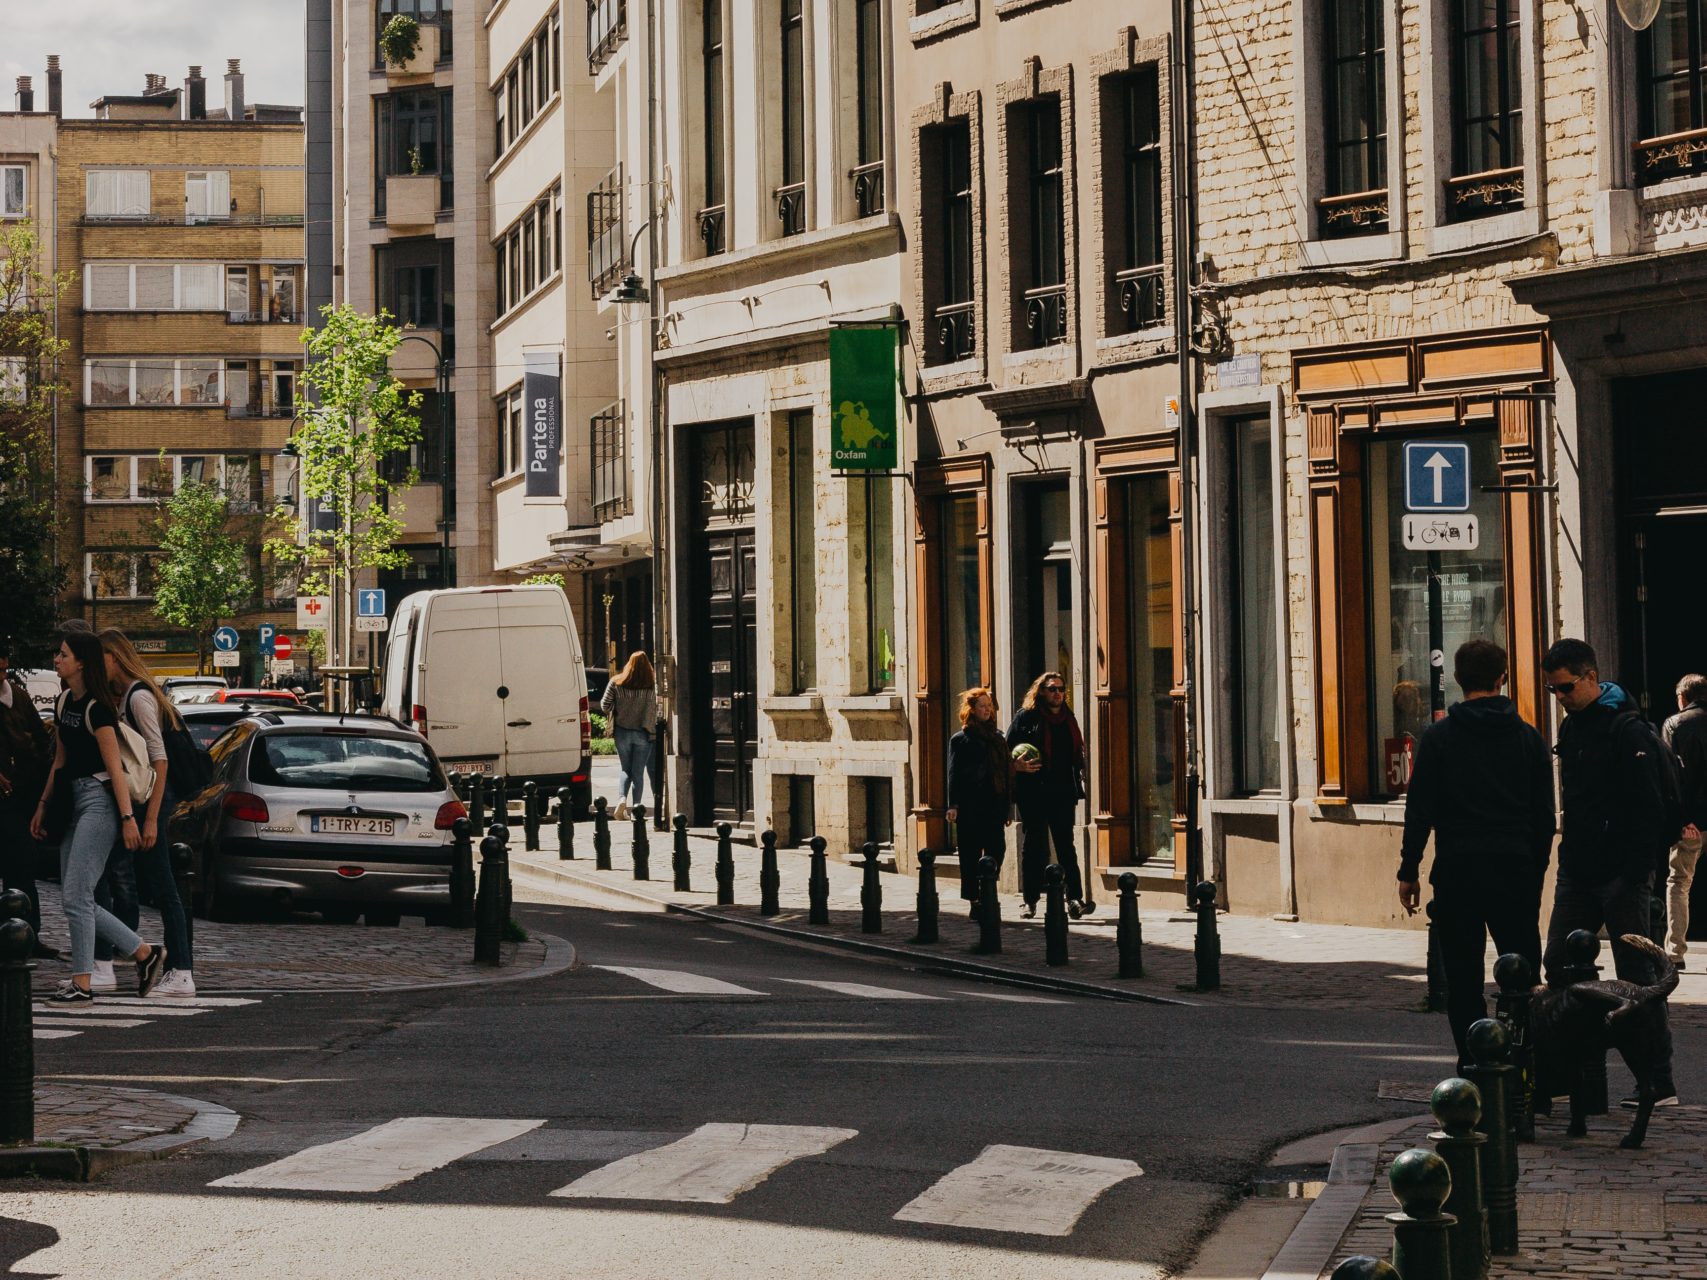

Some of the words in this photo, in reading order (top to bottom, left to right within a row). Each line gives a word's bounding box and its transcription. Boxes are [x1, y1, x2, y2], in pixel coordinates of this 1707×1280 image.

[530, 398, 547, 472] Partena
[835, 450, 867, 459] Oxfam
[260, 627, 273, 644] P
[321, 818, 393, 833] 1-TRY-215
